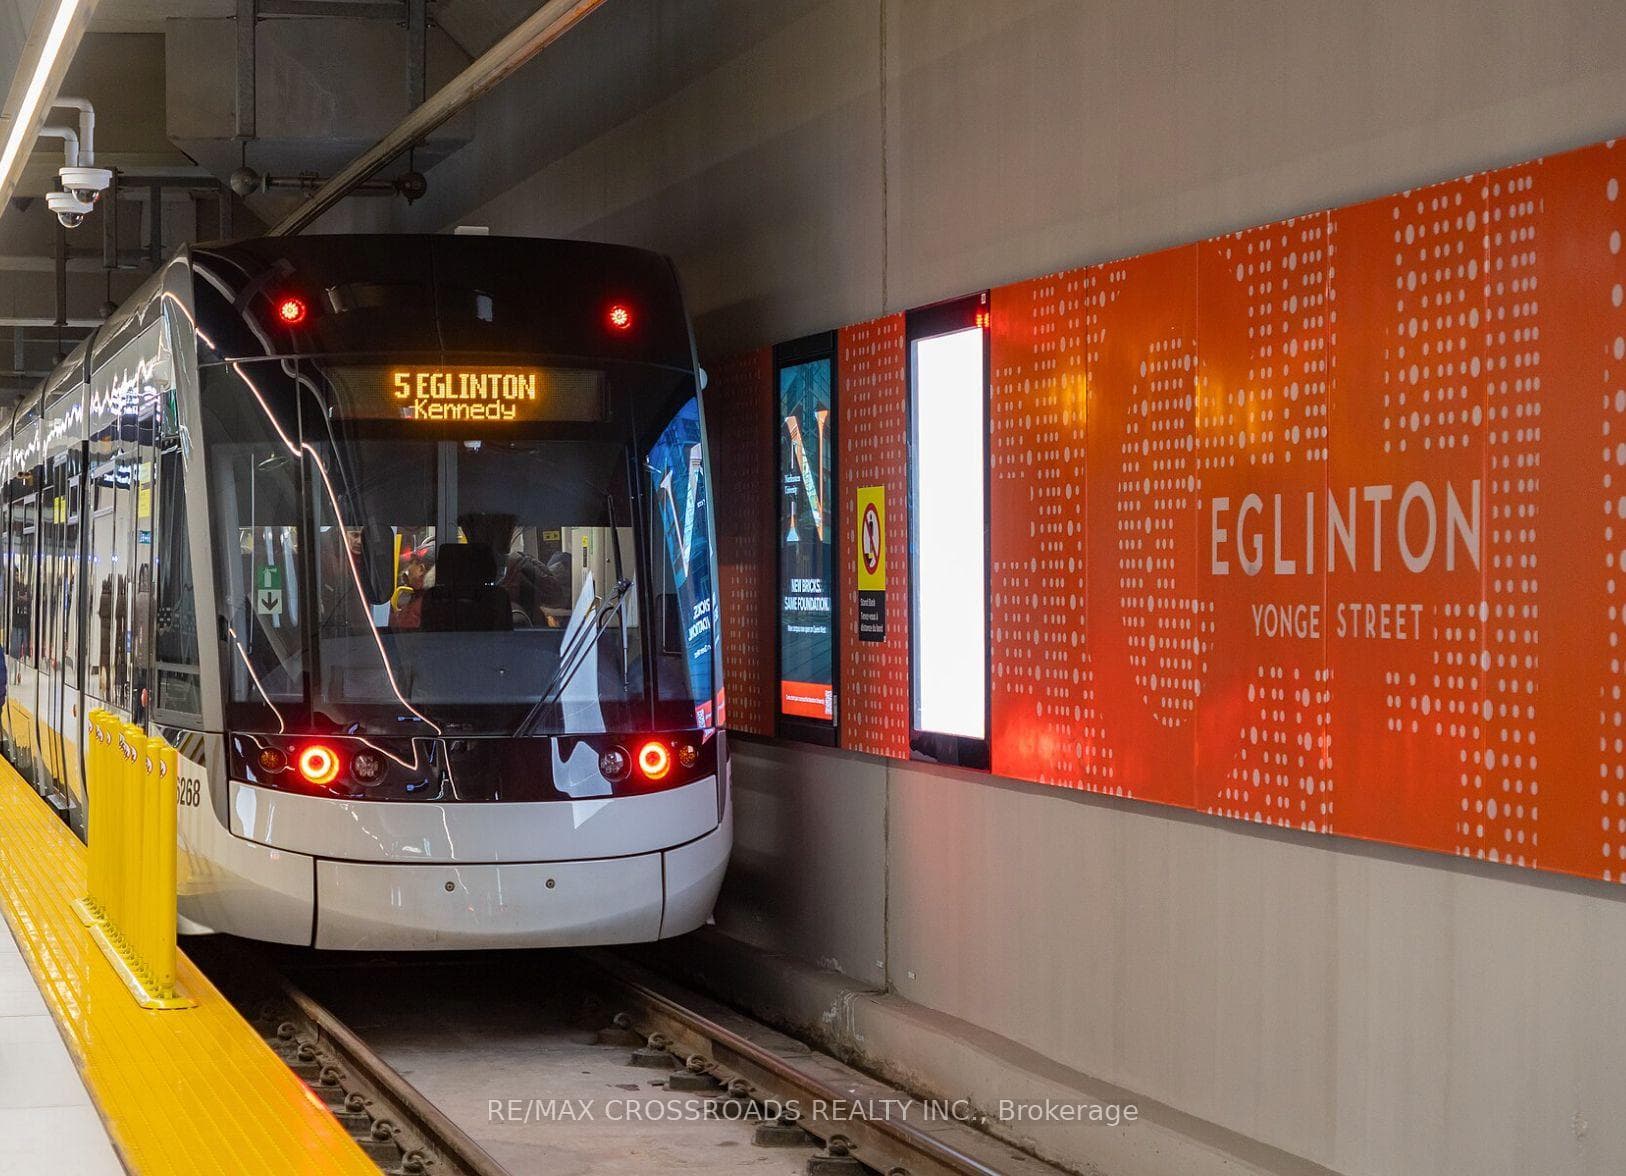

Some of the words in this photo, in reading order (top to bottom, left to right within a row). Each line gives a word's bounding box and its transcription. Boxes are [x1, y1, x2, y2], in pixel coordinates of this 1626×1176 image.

[394, 372, 410, 399] 5
[416, 373, 536, 400] EGLINTON
[414, 399, 516, 420] Kennedy
[1211, 479, 1481, 577] EGLINTON
[1251, 603, 1320, 639] YONGE
[1336, 602, 1424, 640] STREET
